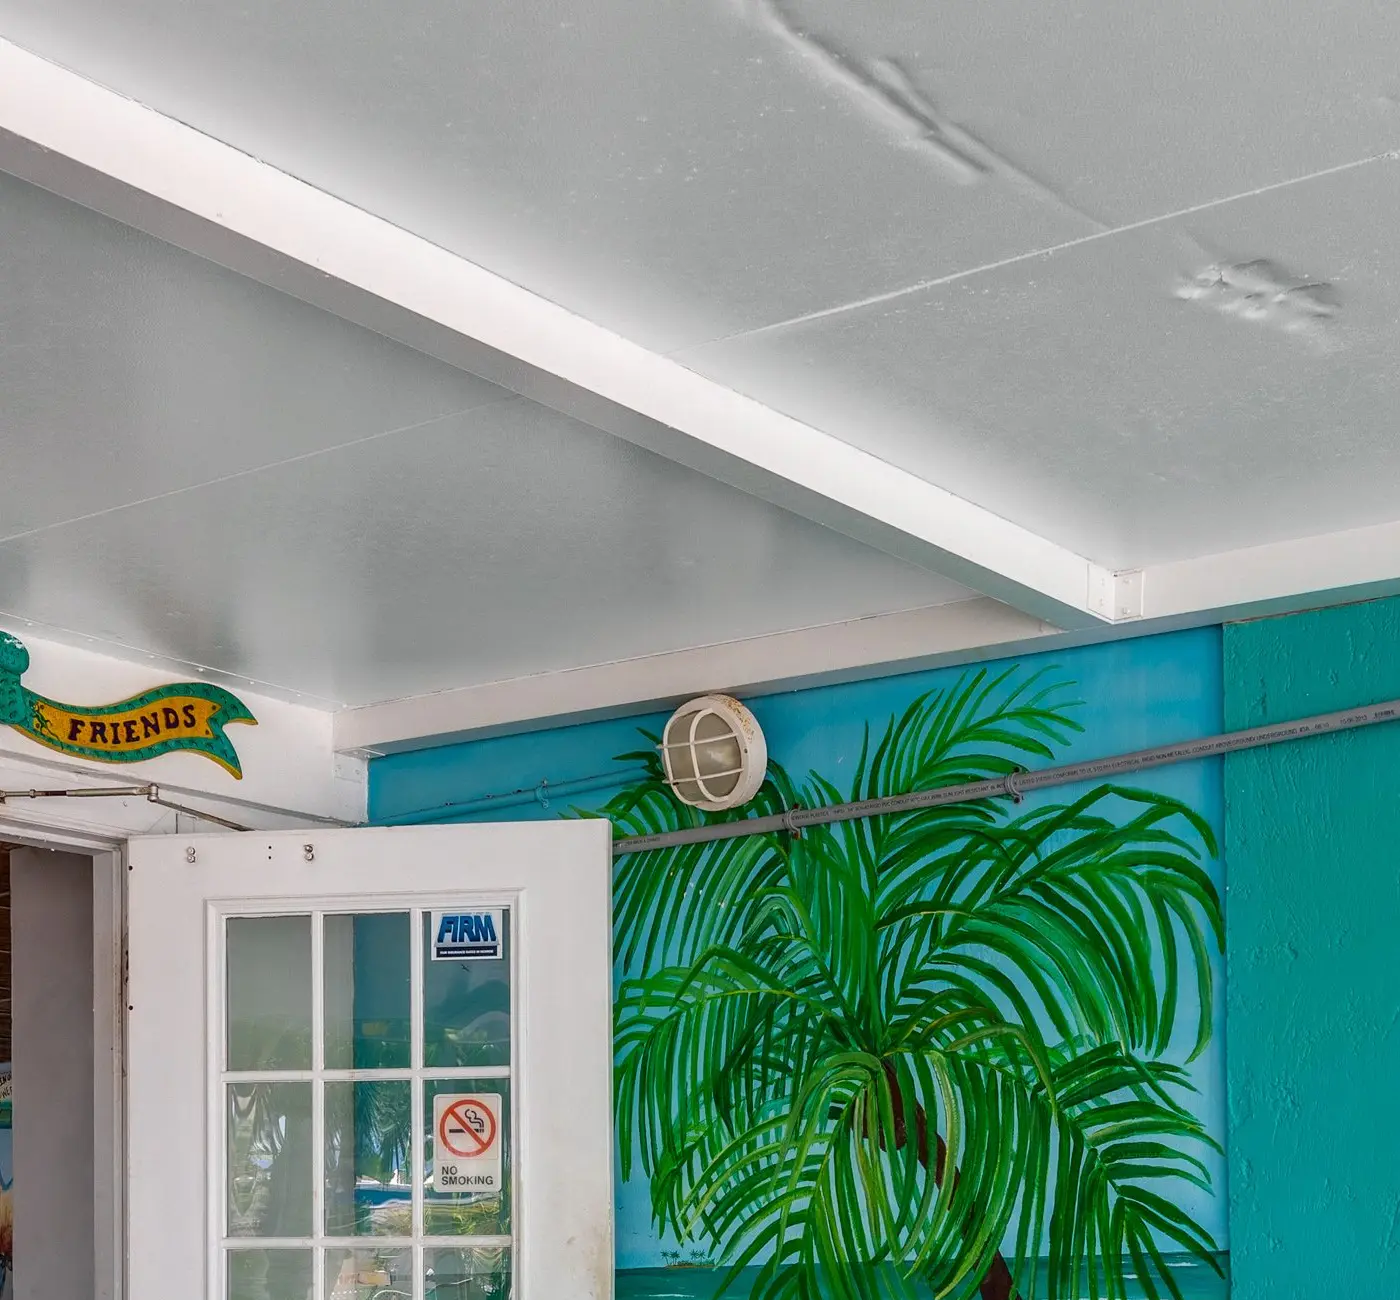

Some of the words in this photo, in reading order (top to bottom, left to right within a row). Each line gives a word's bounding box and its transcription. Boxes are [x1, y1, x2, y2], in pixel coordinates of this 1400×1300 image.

[68, 705, 196, 744] FRIENDS
[437, 915, 497, 943] FIRM
[441, 1165, 458, 1175] NO
[441, 1175, 494, 1186] SMOKING
